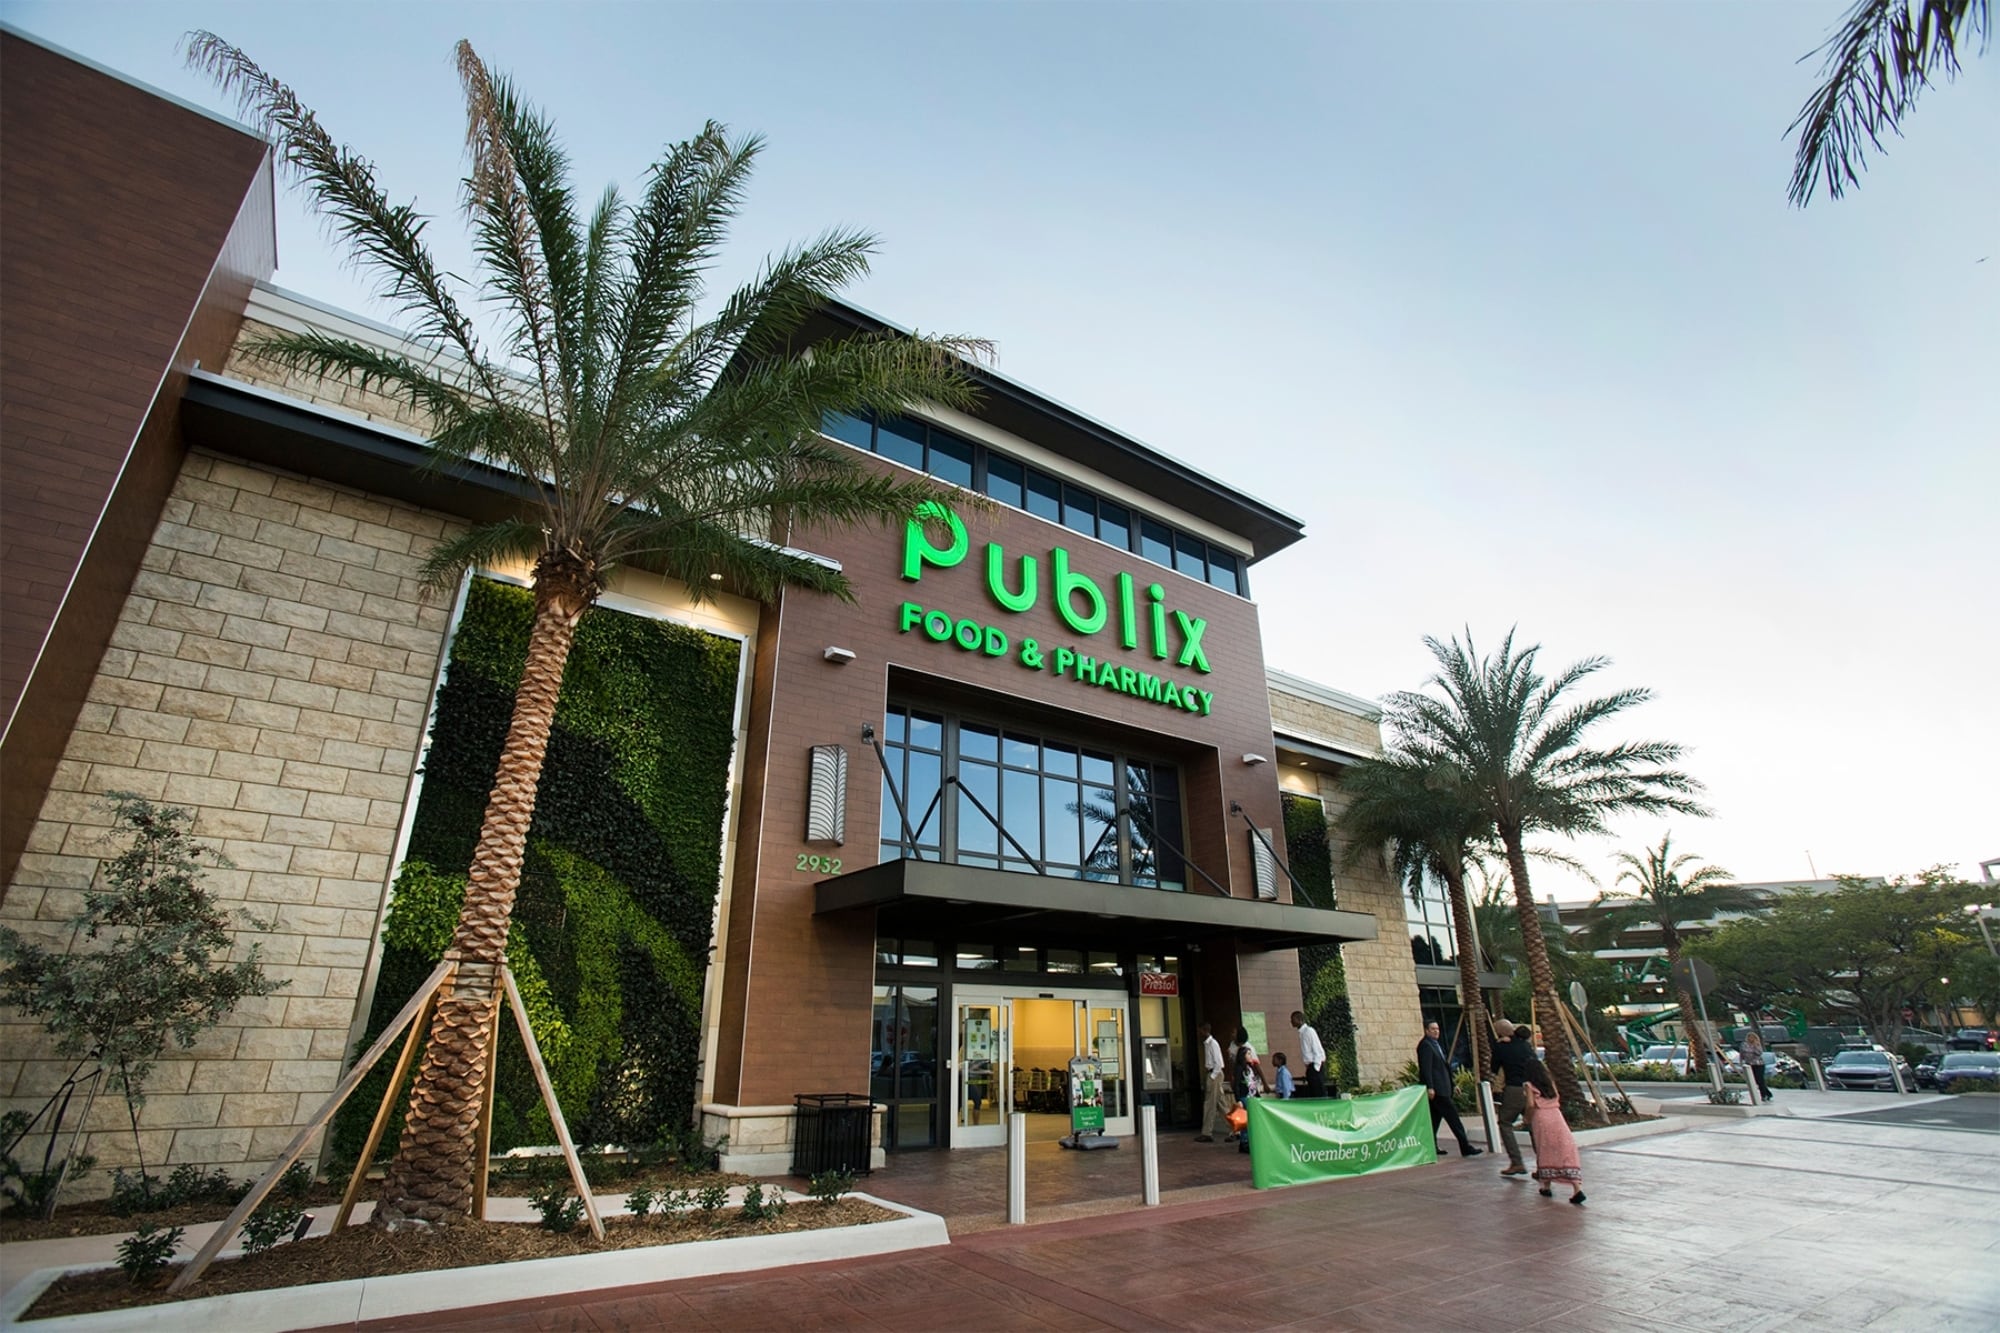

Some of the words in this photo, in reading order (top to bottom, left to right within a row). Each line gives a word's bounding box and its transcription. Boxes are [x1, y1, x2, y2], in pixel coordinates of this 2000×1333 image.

[901, 500, 1213, 674] Publix
[900, 601, 1008, 657] FOOD
[1020, 638, 1044, 670] &
[1054, 647, 1213, 716] PHARMACY
[796, 853, 842, 876] 2952
[1143, 979, 1176, 991] Presto!
[1290, 1143, 1358, 1164] November
[1361, 1143, 1371, 1162] 9,
[1375, 1138, 1397, 1160] 7:00
[1397, 1134, 1421, 1150] a.m.
